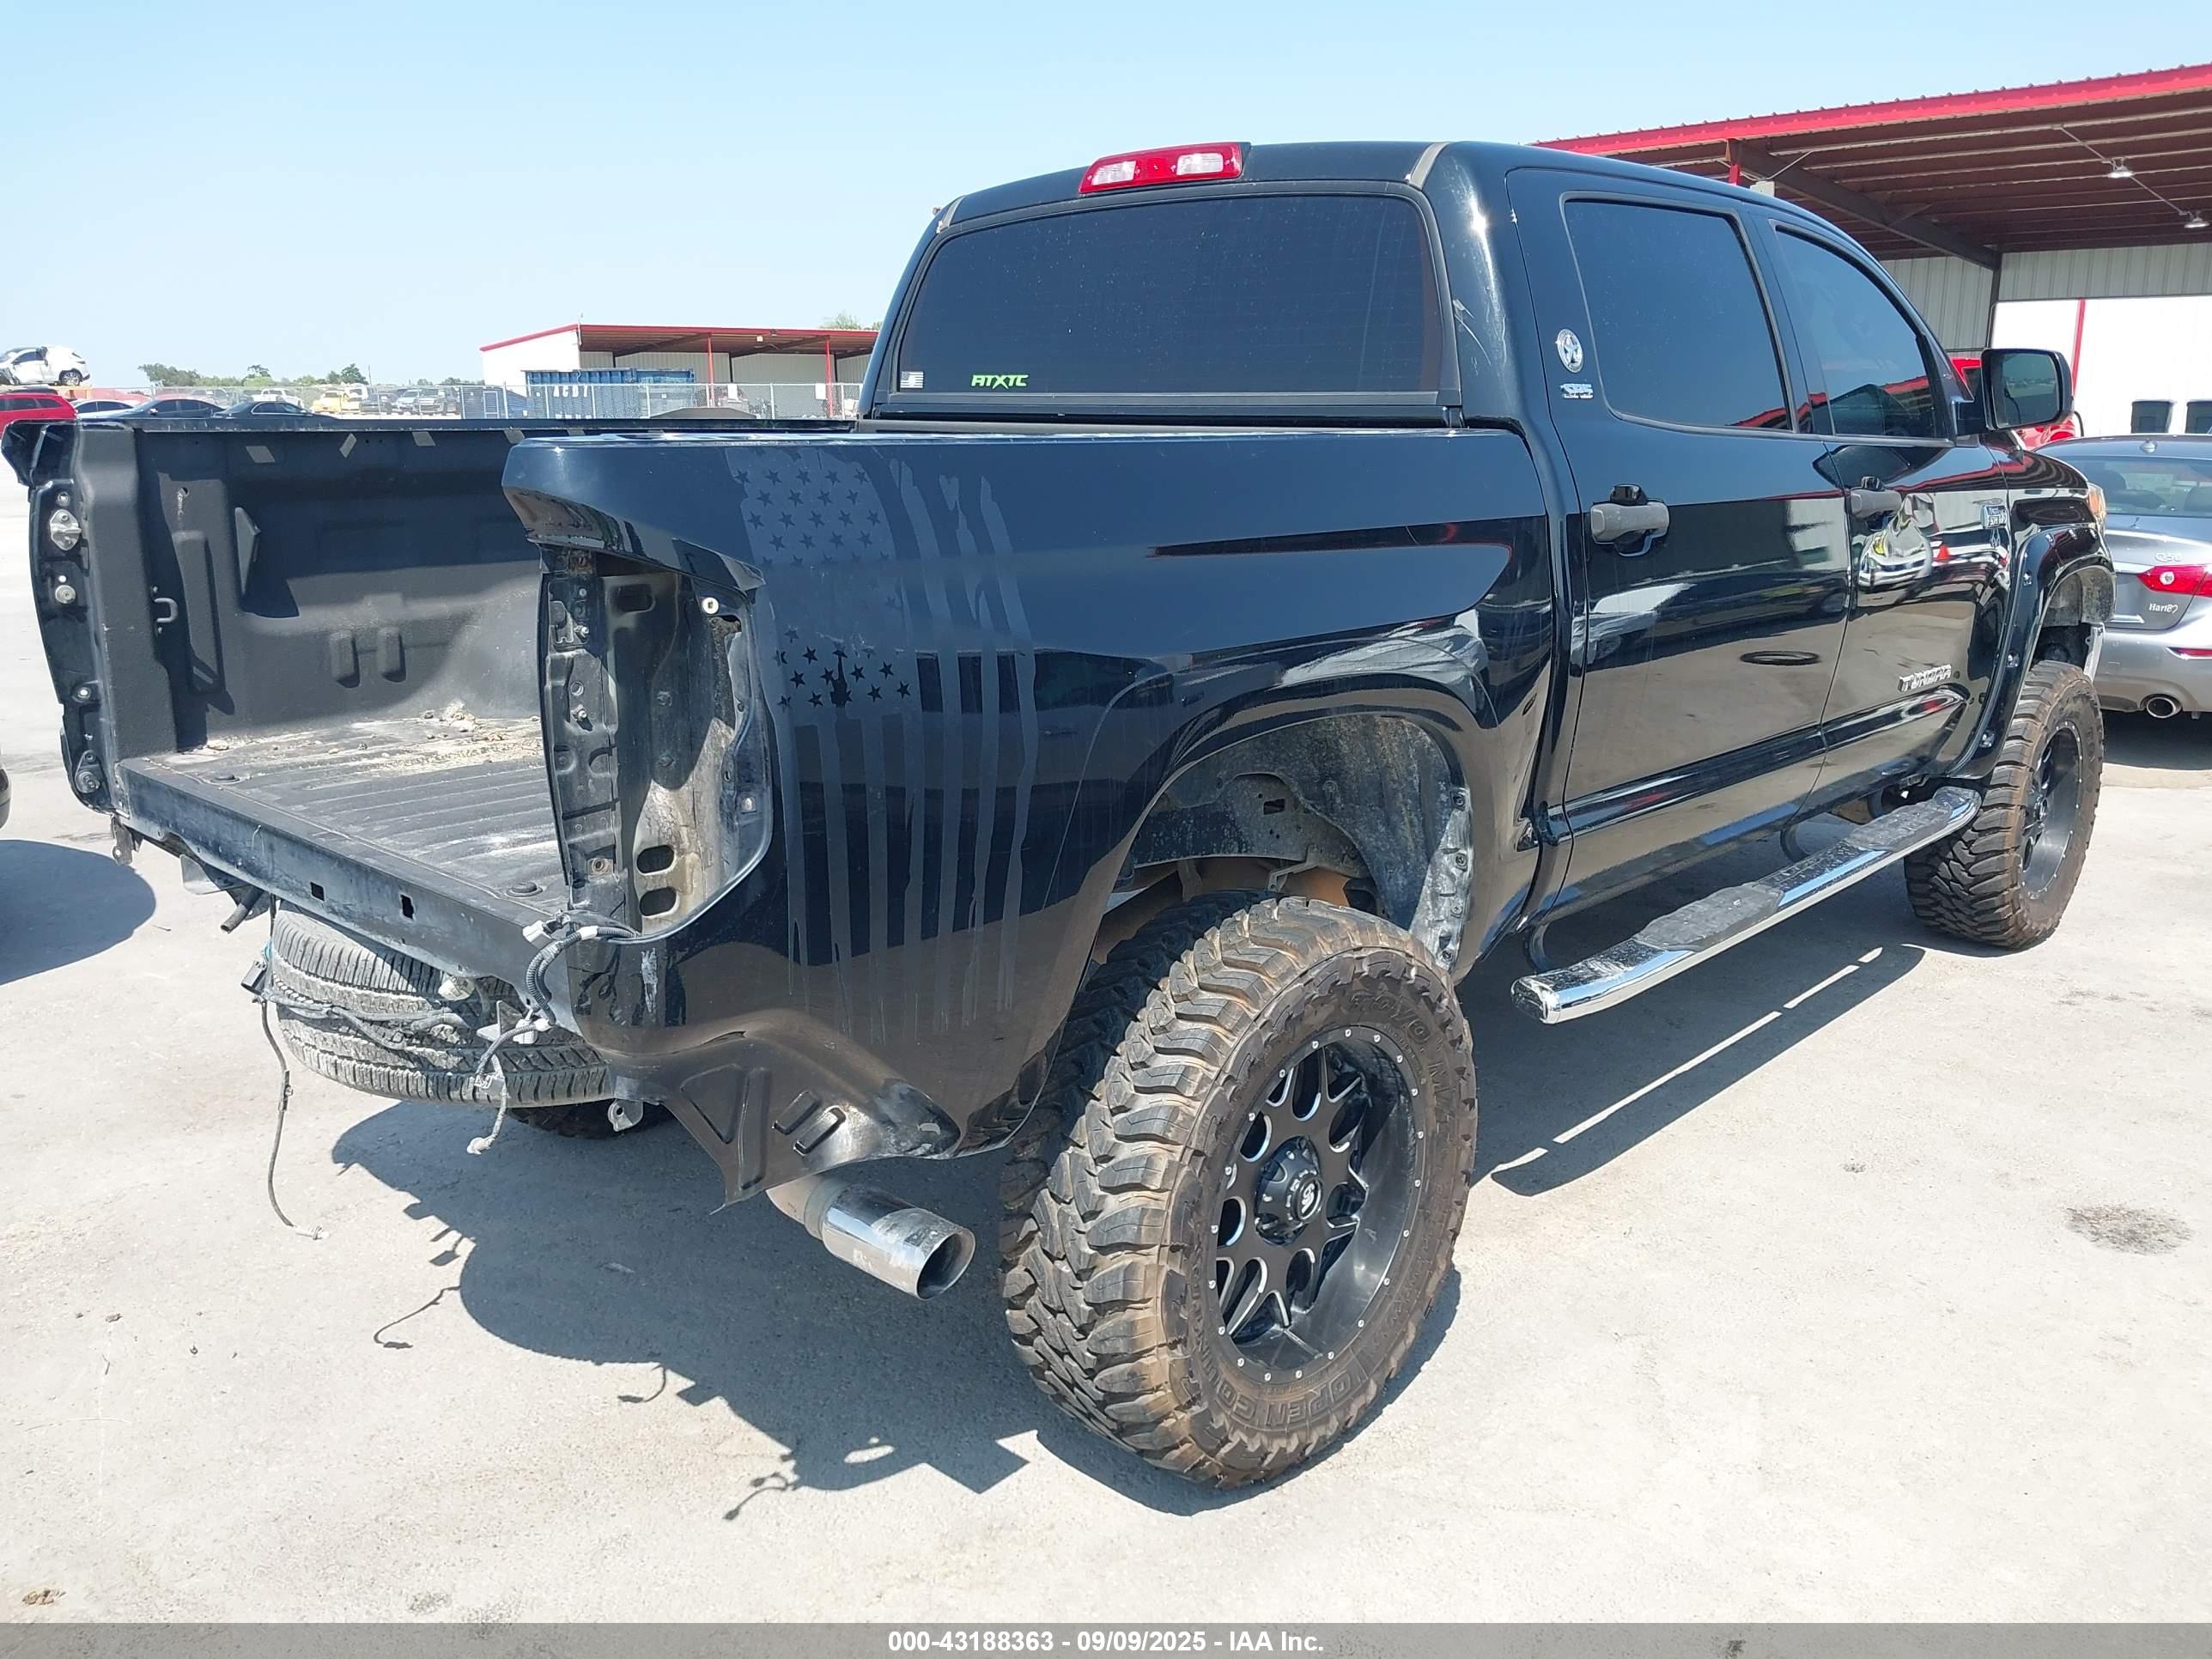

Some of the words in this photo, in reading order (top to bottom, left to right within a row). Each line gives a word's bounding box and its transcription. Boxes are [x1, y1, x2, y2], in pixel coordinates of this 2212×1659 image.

[971, 374, 1029, 390] ATXTC
[1899, 664, 1952, 692] TUNDRA
[1264, 1367, 1353, 1426] OPEN
